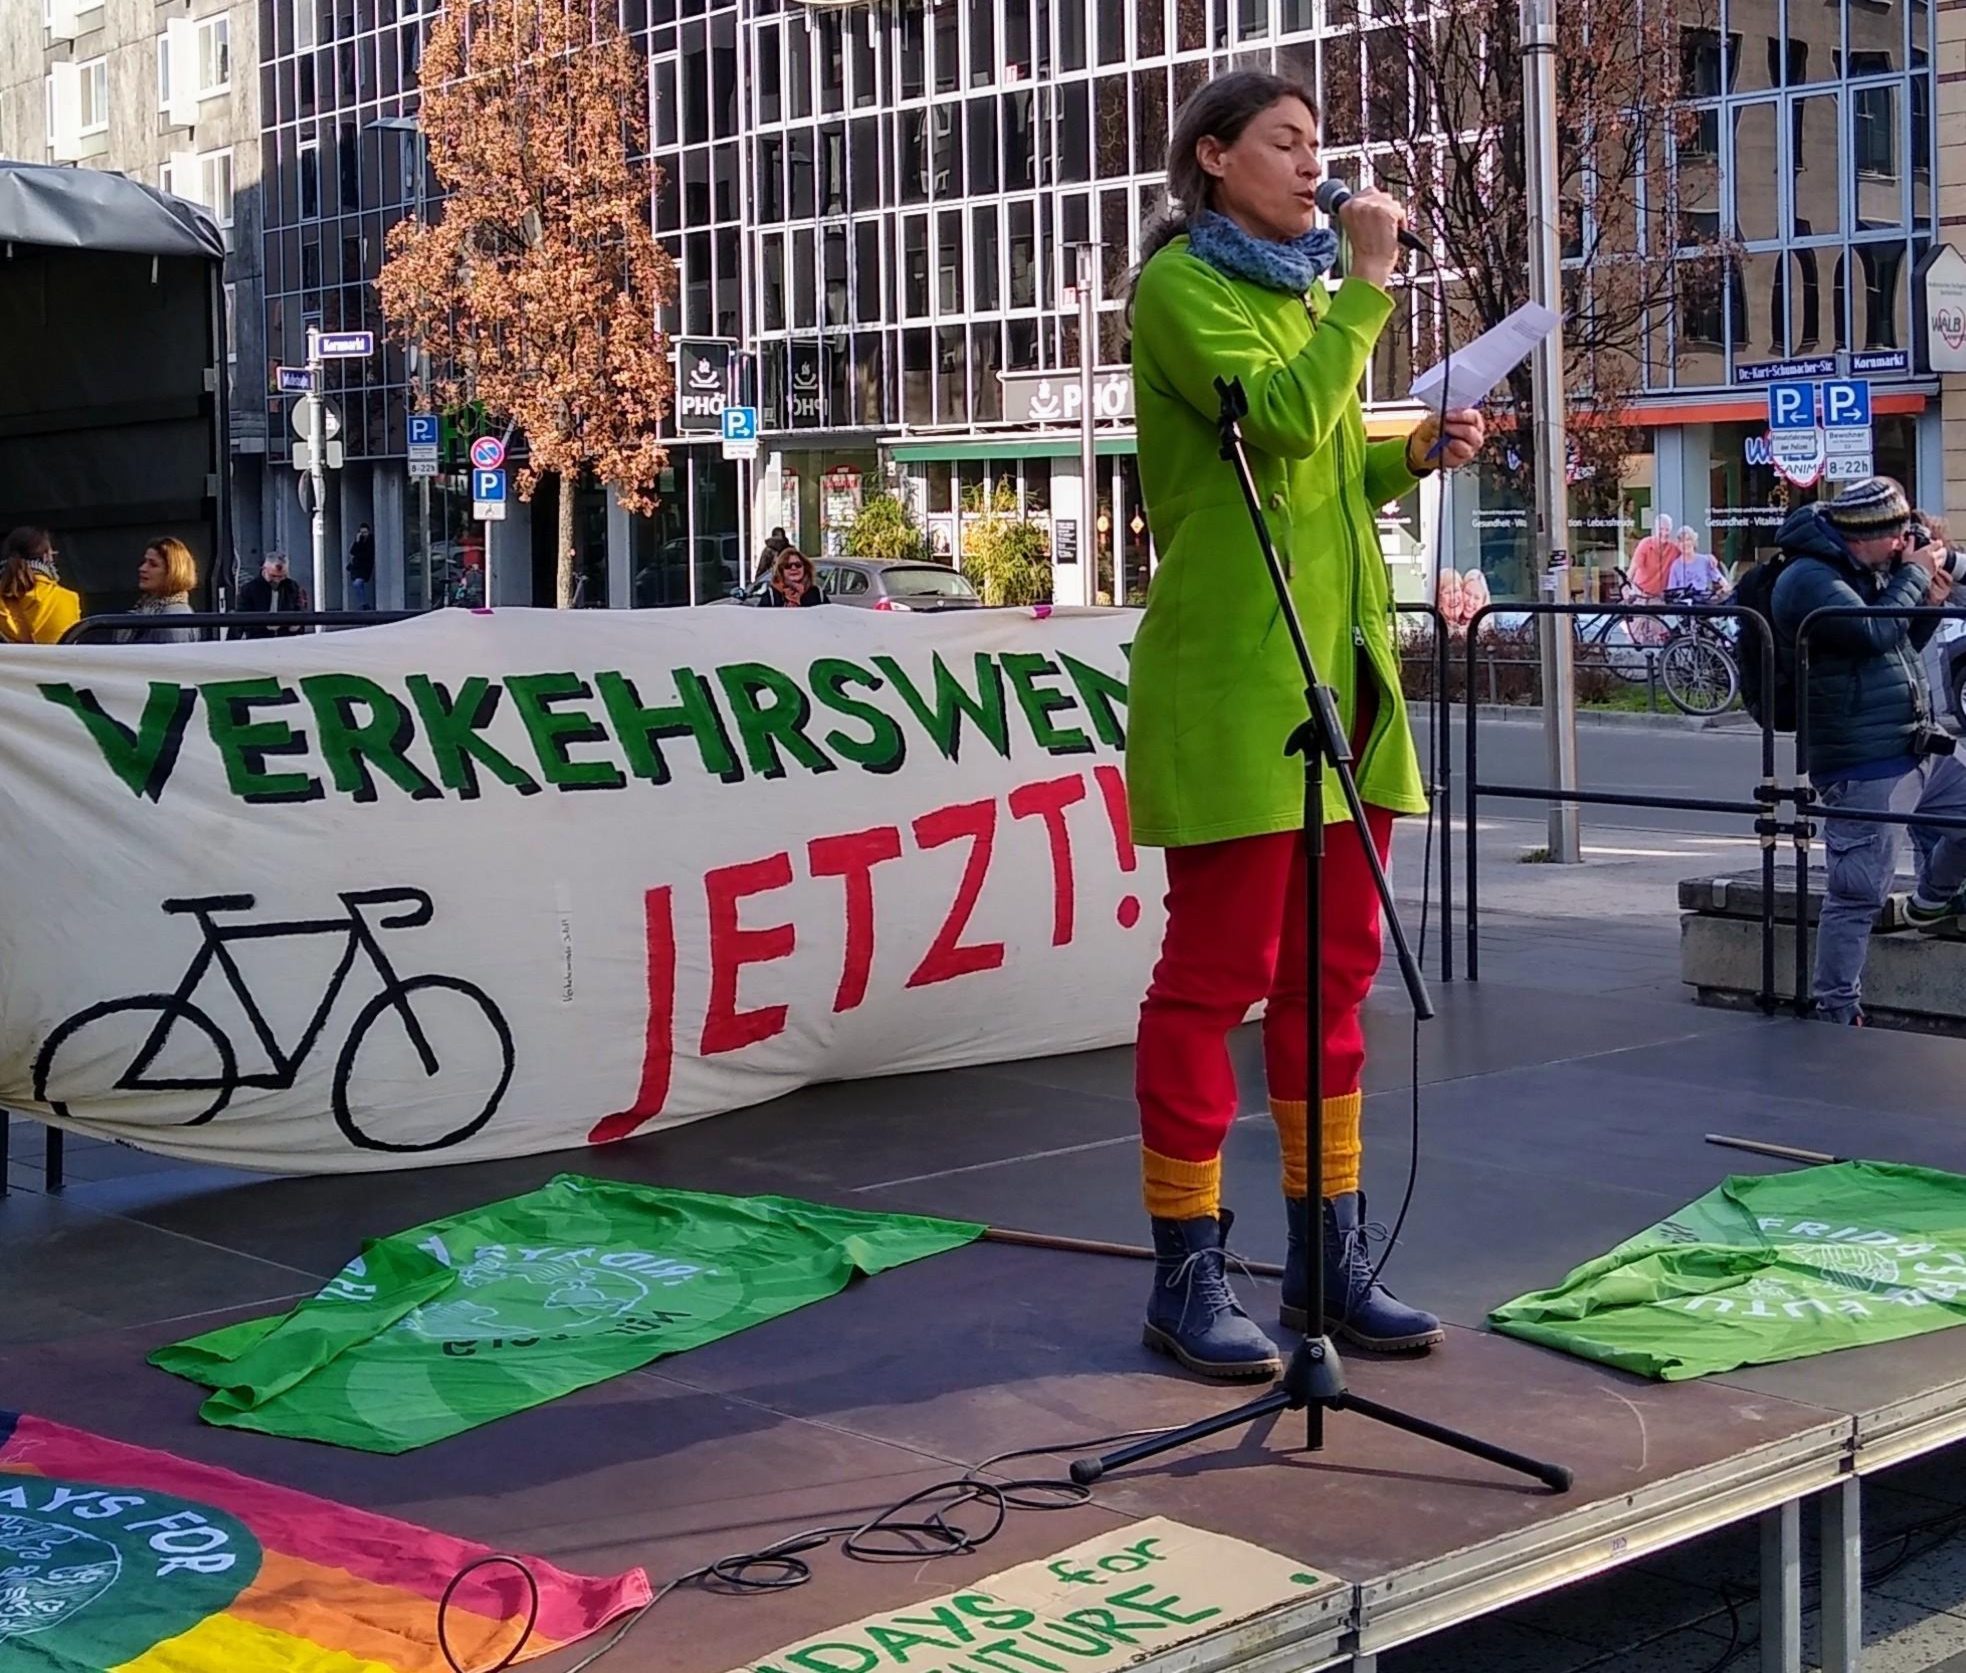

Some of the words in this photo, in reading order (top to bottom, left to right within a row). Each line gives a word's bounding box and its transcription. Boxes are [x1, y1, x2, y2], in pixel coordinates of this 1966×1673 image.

[1931, 316, 1961, 332] WALB
[1854, 354, 1904, 369] Kornmarkt
[1776, 388, 1801, 424] P
[1830, 386, 1855, 422] P
[412, 419, 429, 440] P
[727, 411, 746, 437] P
[480, 473, 498, 497] P
[1829, 461, 1868, 474] 8-22h
[38, 644, 1133, 804] VERKEHRSWEN
[587, 766, 1140, 1144] JETZT!
[123, 1510, 236, 1577] FOR
[757, 1595, 1035, 1673] DAYS
[1046, 1538, 1167, 1585] for
[925, 1584, 1222, 1673] TURE
